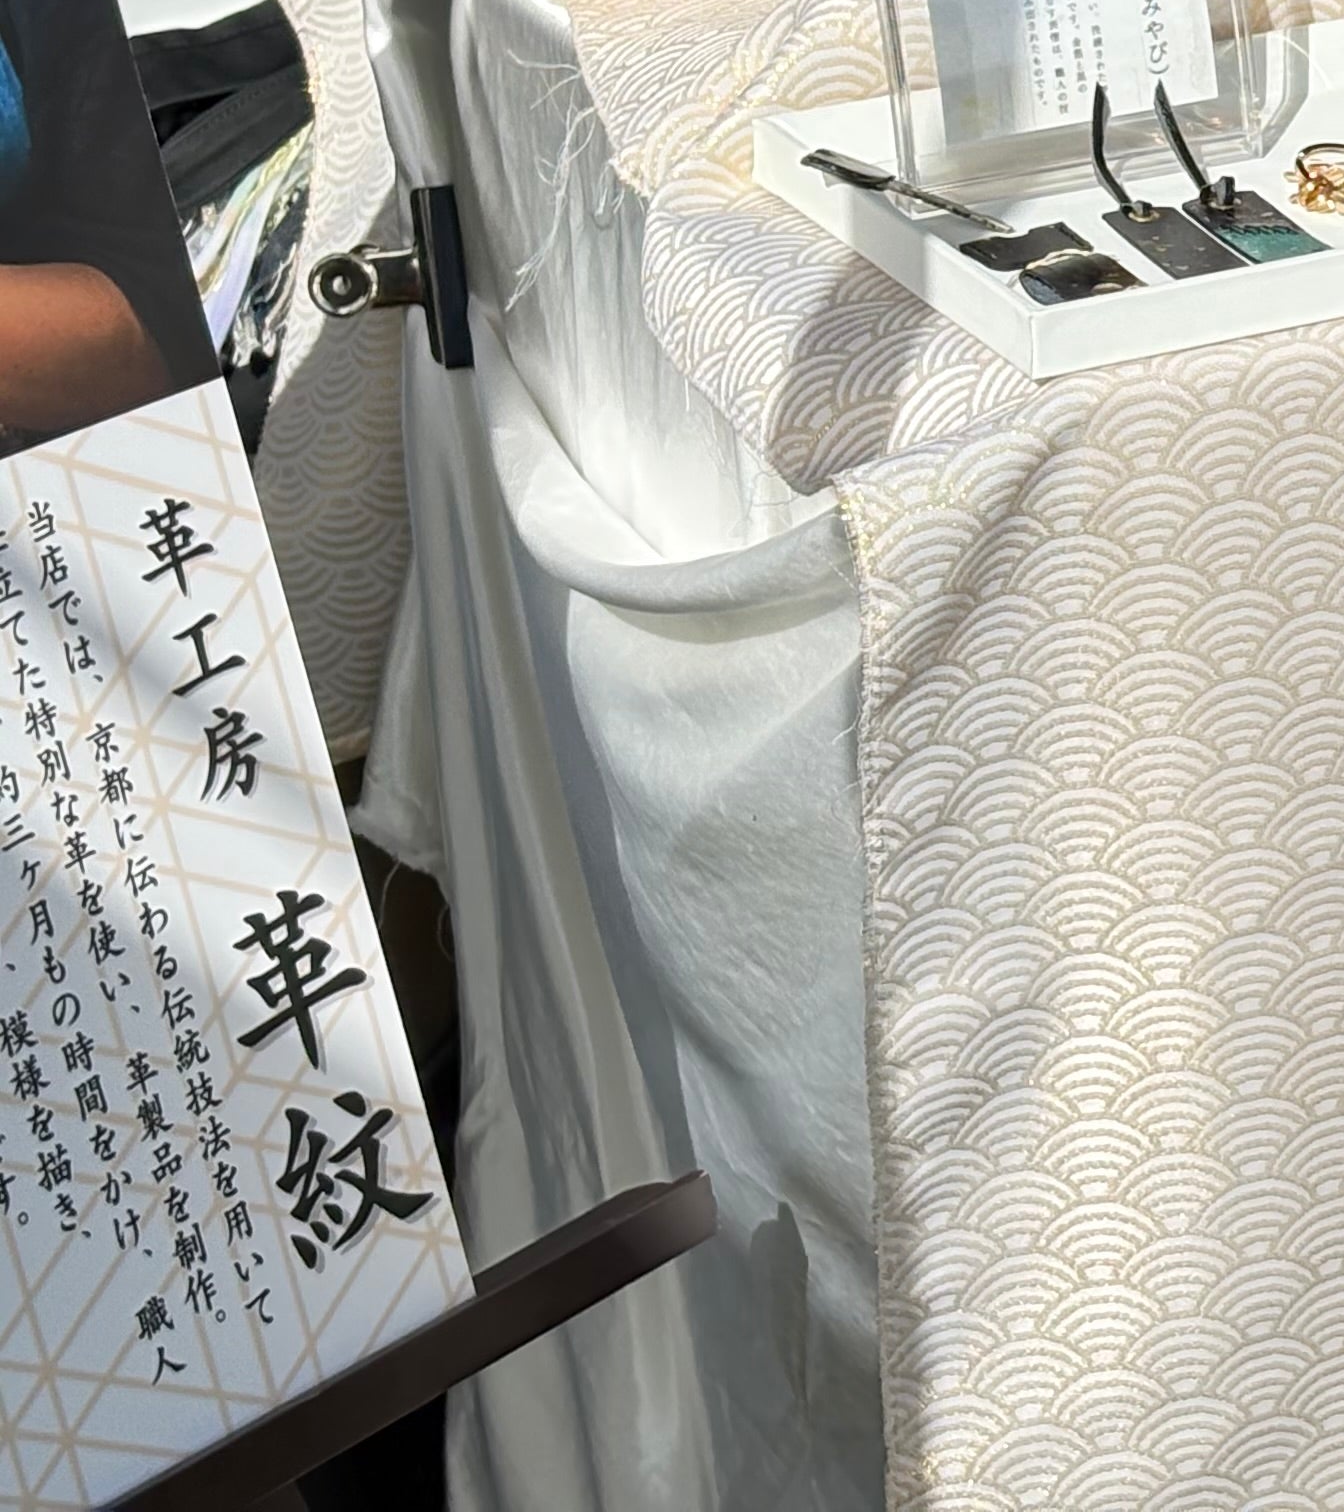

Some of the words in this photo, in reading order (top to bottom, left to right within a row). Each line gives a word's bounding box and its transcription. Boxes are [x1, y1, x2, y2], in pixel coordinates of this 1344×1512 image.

[0, 531, 228, 1324] 立てた特別な革を使い、革製品を制作。
[140, 498, 265, 801] 革工房
[233, 890, 435, 1270] 革紋
